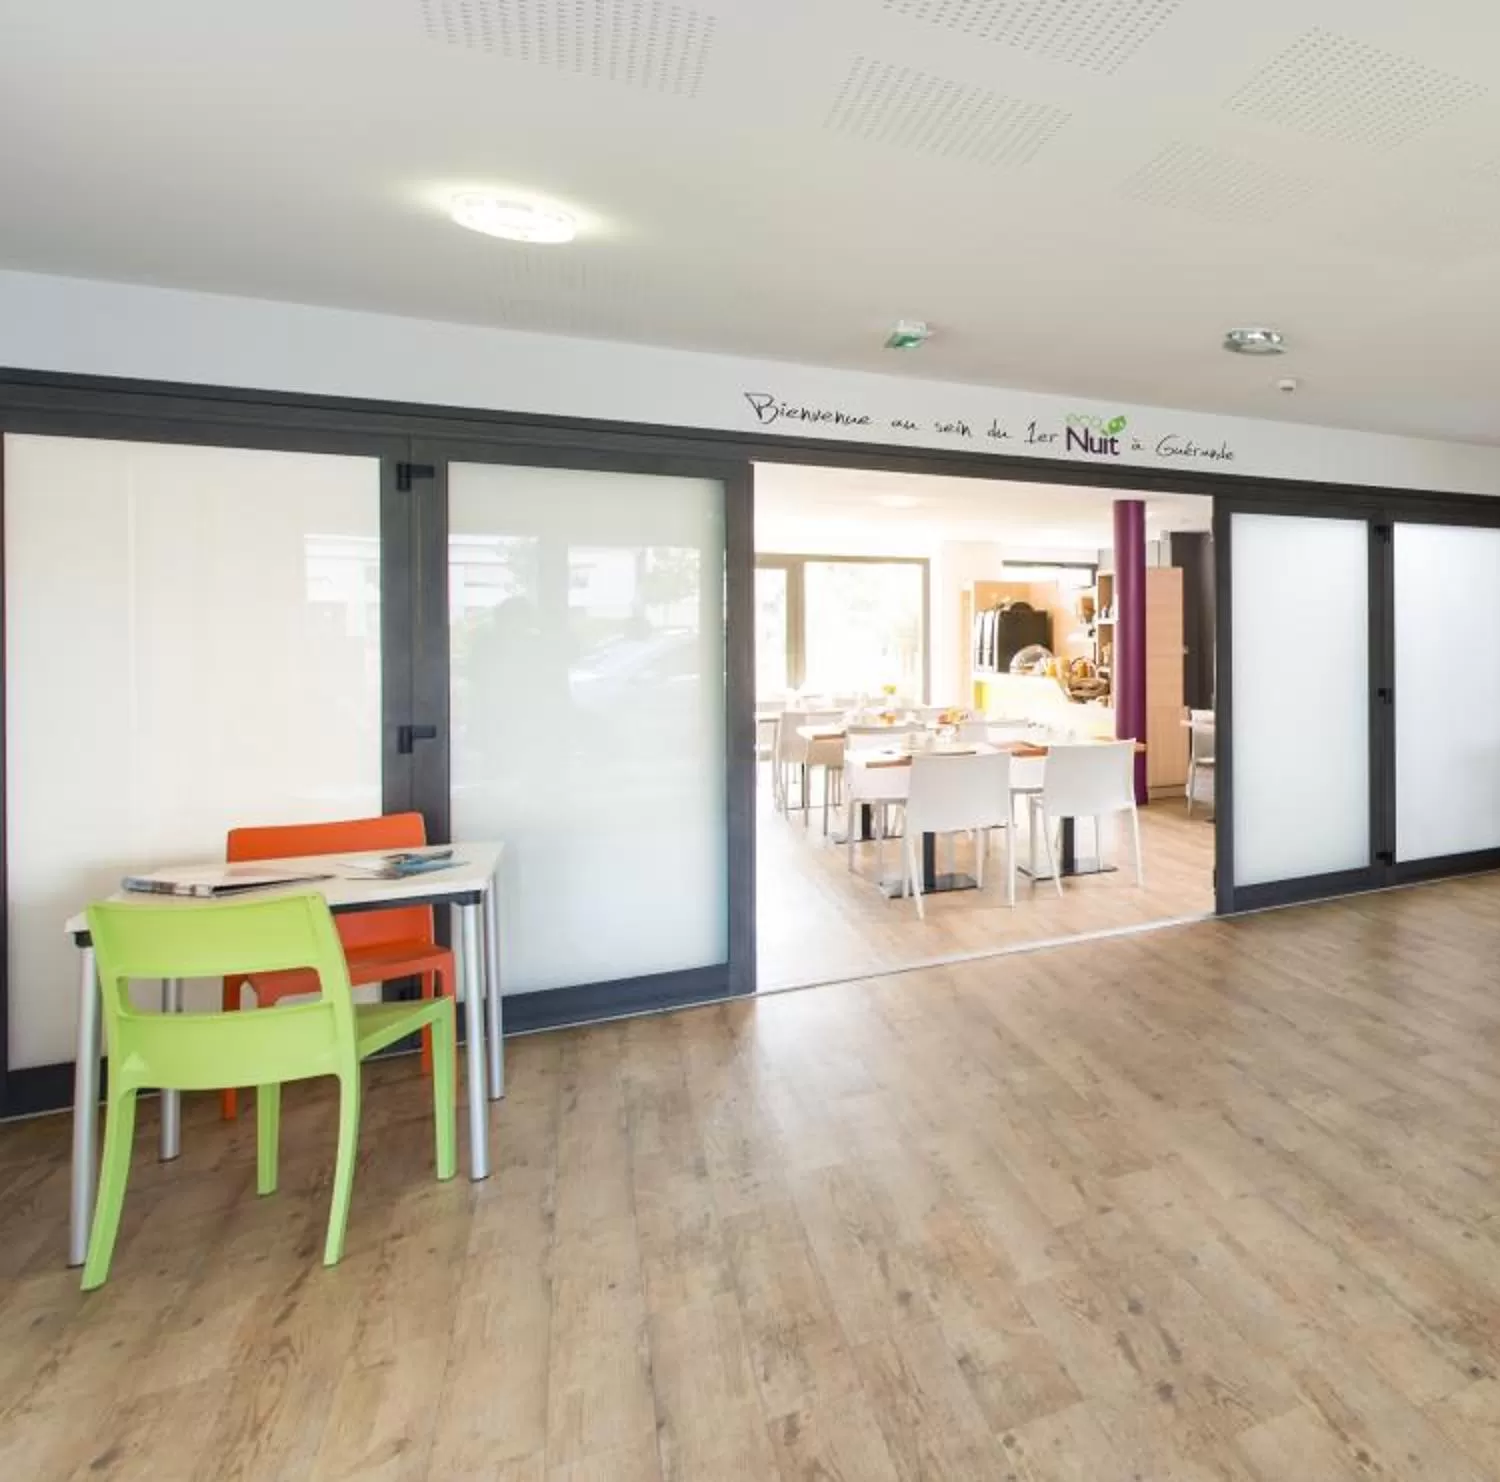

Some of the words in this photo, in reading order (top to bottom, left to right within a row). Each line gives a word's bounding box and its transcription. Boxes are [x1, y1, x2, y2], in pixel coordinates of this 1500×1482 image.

[744, 392, 871, 425] Bienvenue
[891, 419, 920, 431] au
[934, 420, 973, 438] sein
[987, 418, 1013, 438] du
[1024, 420, 1059, 443] 1er
[1065, 425, 1121, 456] Nuit
[1131, 437, 1145, 451] à
[1155, 433, 1234, 461] Guérande
